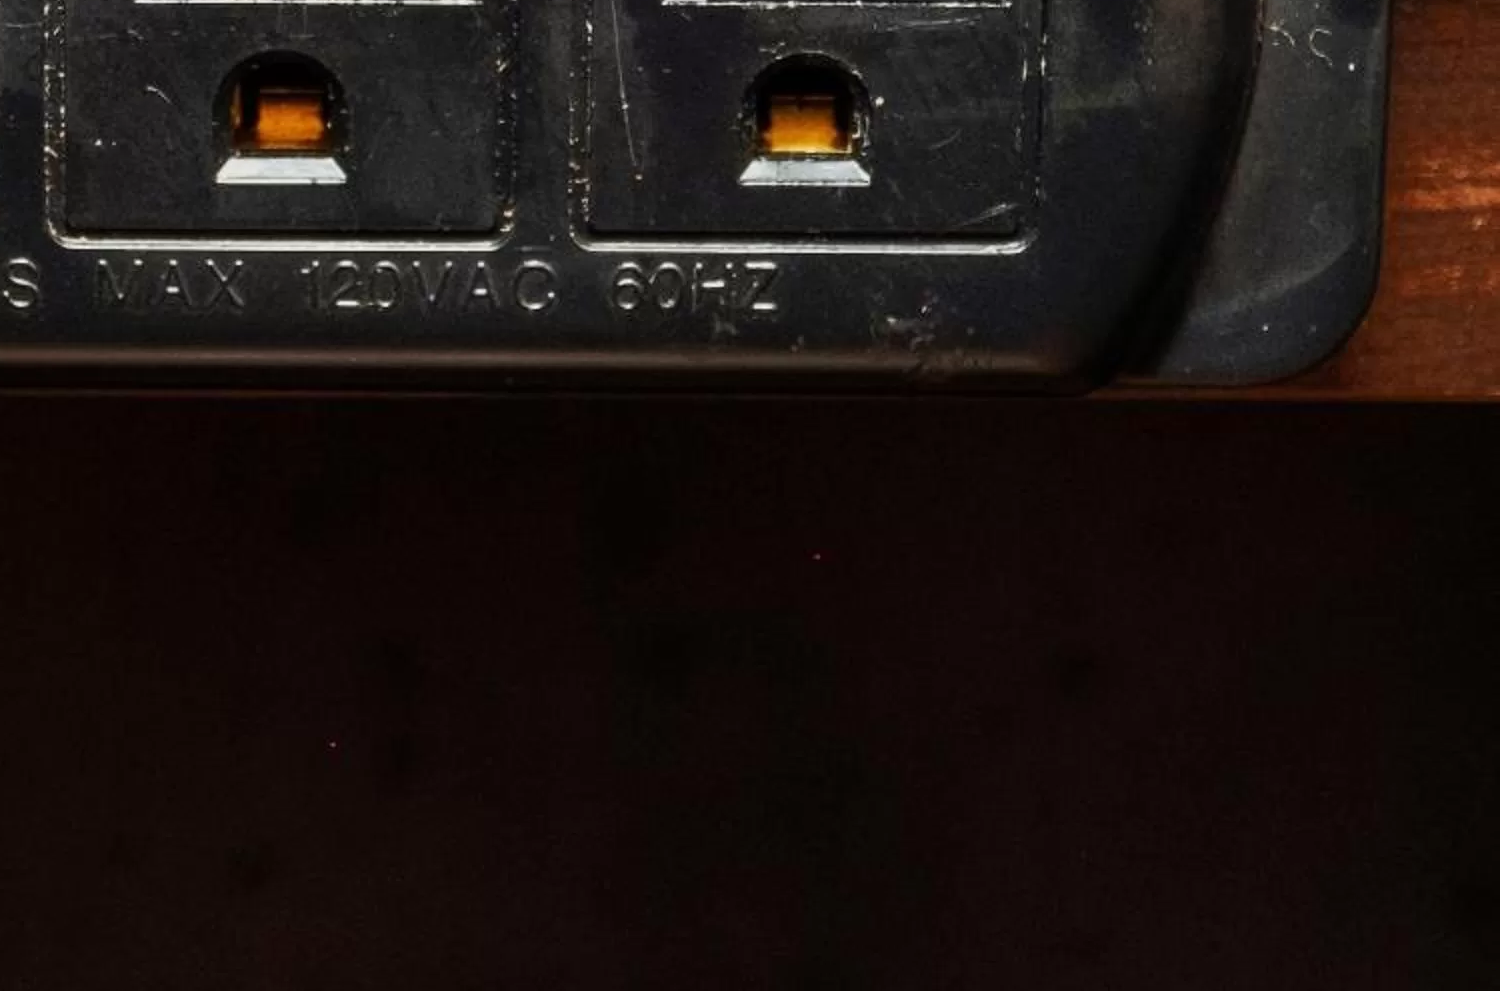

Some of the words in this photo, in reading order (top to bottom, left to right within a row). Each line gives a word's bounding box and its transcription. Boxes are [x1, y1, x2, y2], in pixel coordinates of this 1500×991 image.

[97, 257, 247, 310] MAX
[300, 258, 560, 313] 120VAC
[614, 258, 780, 314] 60HZ
